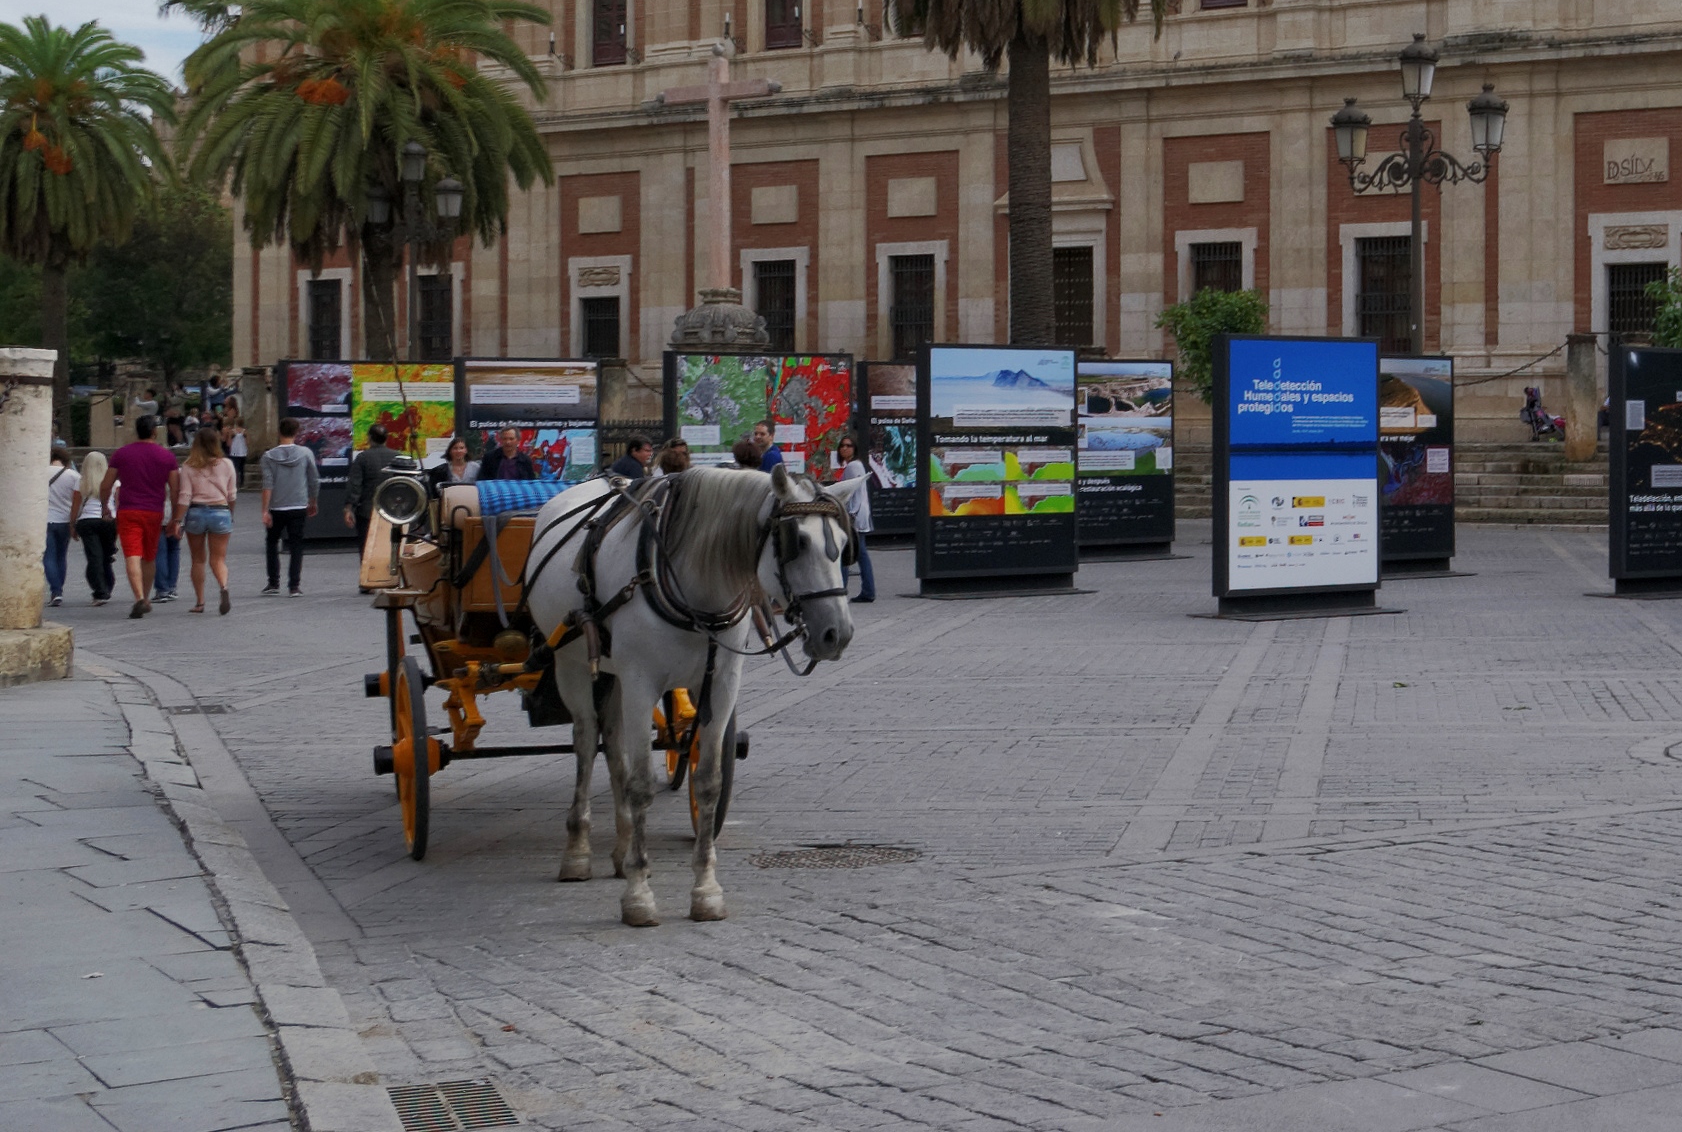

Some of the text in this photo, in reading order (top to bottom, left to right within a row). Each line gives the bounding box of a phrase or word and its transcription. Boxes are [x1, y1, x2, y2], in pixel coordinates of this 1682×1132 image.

[1252, 379, 1322, 392] Teledetección
[1244, 390, 1355, 405] Humedales y espacios
[1238, 401, 1294, 415] protegidos
[934, 434, 1049, 445] Tomando la temperatura al mar
